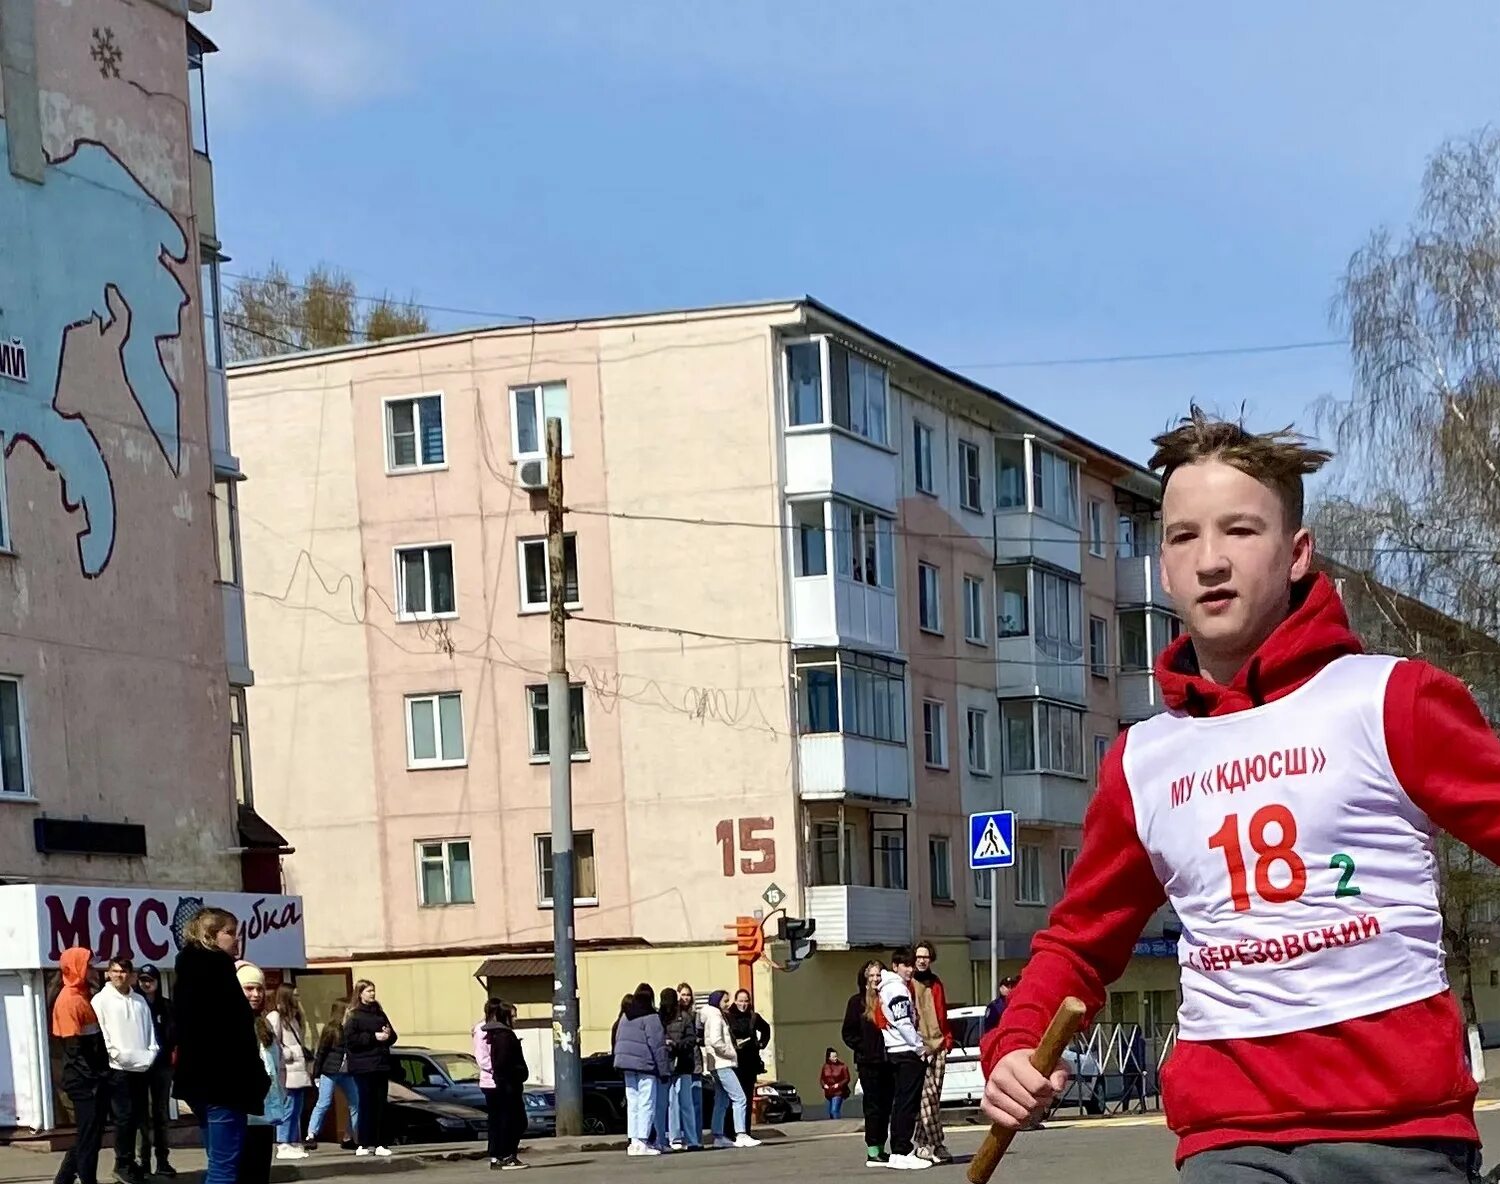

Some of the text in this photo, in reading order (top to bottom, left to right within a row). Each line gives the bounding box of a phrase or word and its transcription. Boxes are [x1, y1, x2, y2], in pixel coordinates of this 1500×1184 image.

[1171, 771, 1196, 809] МУ
[716, 816, 776, 877] 15
[1208, 804, 1307, 912] 18
[766, 889, 781, 904] 15
[1329, 853, 1362, 900] 2
